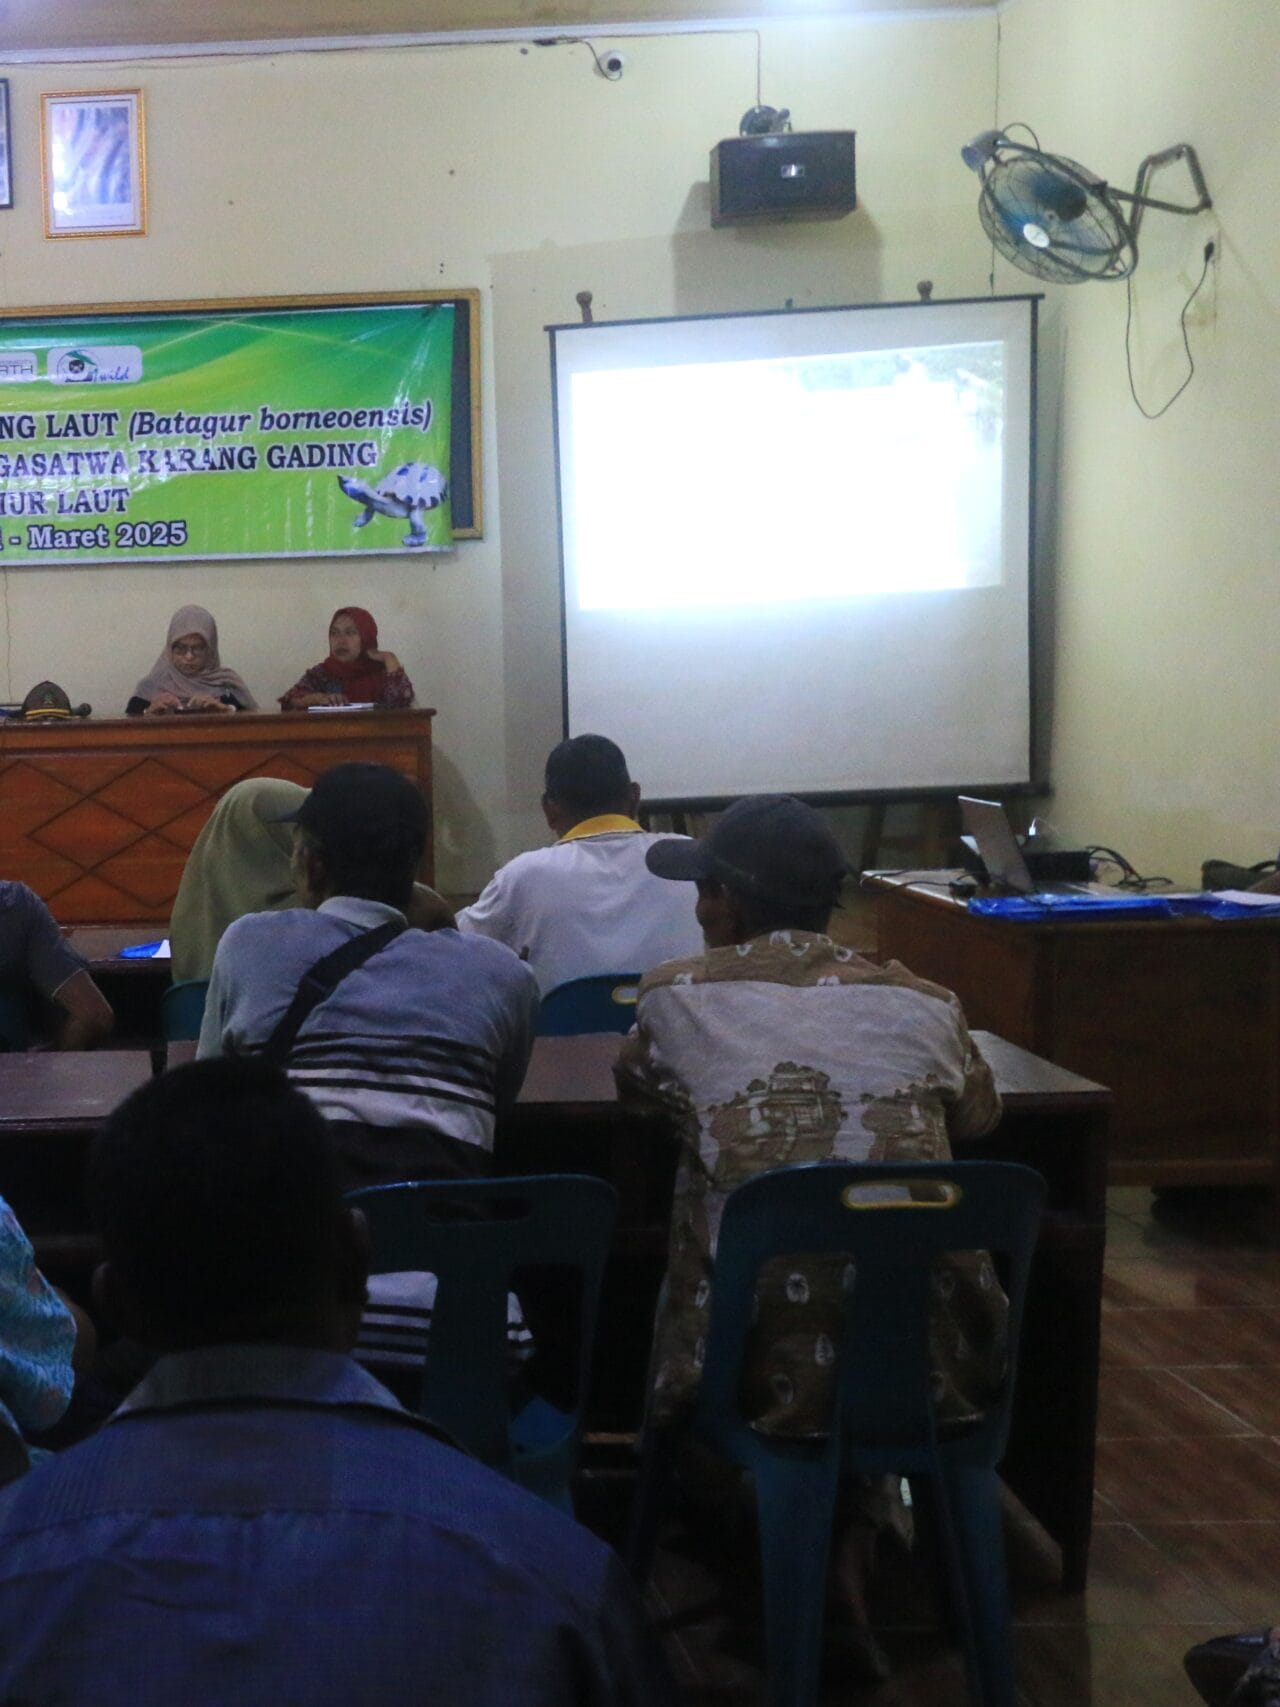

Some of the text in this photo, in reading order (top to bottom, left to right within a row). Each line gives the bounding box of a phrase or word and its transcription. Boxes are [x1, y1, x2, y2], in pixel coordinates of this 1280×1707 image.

[45, 411, 119, 439] LAUT
[128, 409, 252, 441] (Batagur
[259, 400, 432, 432] borneoensis)
[137, 445, 258, 474] KARANG
[265, 441, 378, 470] GADING
[56, 488, 131, 515] LAUT
[27, 523, 110, 550] Maret
[115, 521, 188, 548] 2025
